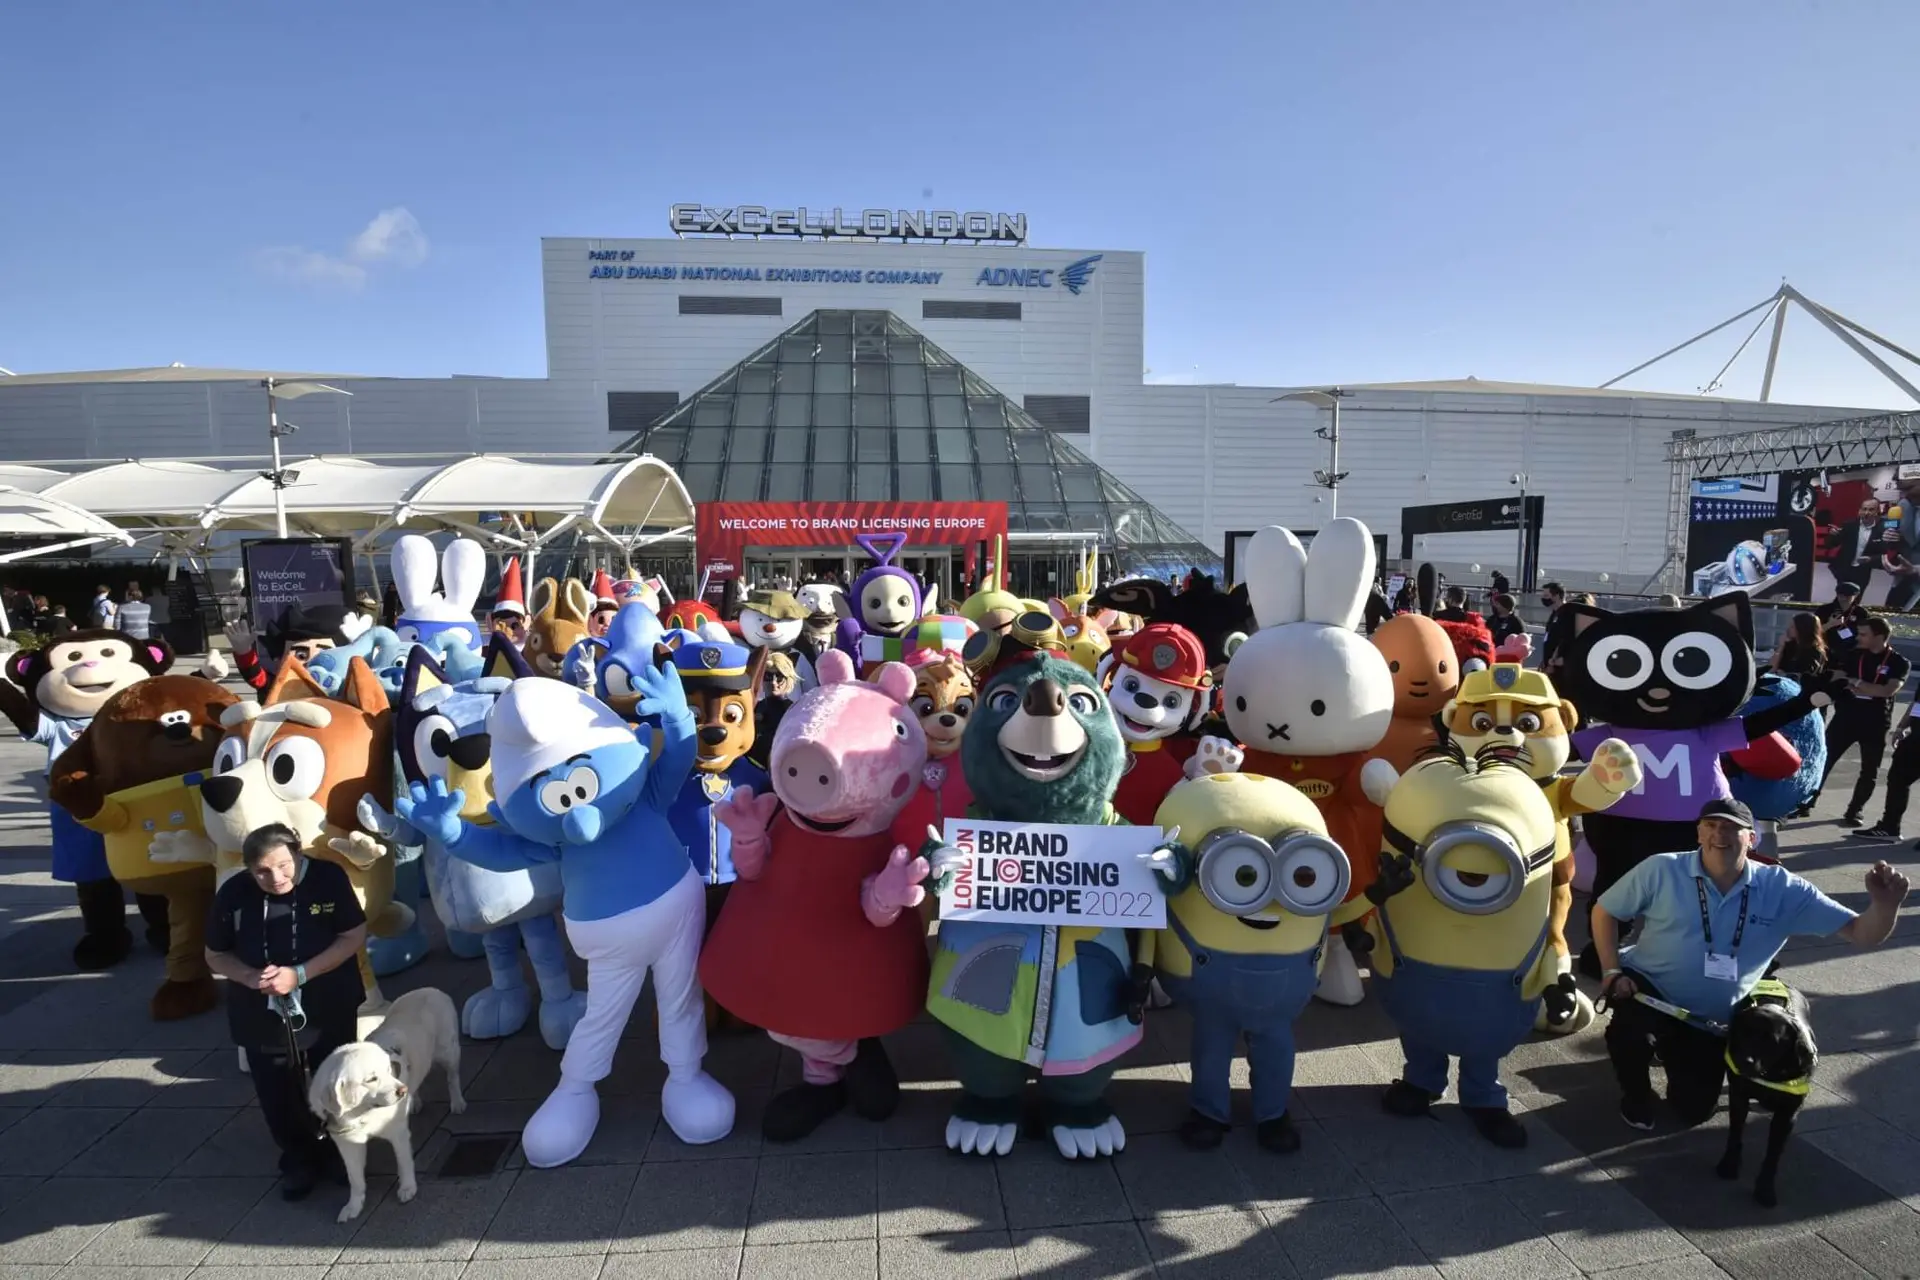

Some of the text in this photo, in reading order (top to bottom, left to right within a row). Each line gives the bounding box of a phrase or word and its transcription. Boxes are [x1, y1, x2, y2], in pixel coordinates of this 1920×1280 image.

[834, 207, 1026, 240] LONDON
[589, 250, 635, 261] PART OF
[589, 265, 943, 285] ABU DHABI NATIONAL EXHIBITIONS COMPANY
[976, 266, 1054, 288] ADNEC
[719, 517, 986, 529] WELCOME TO BRAND LICENSING EUROPE
[1451, 509, 1483, 522] CentrEd
[257, 570, 306, 580] Welcome
[258, 582, 268, 592] to
[1631, 743, 1693, 796] M
[977, 829, 1068, 858] BRAND
